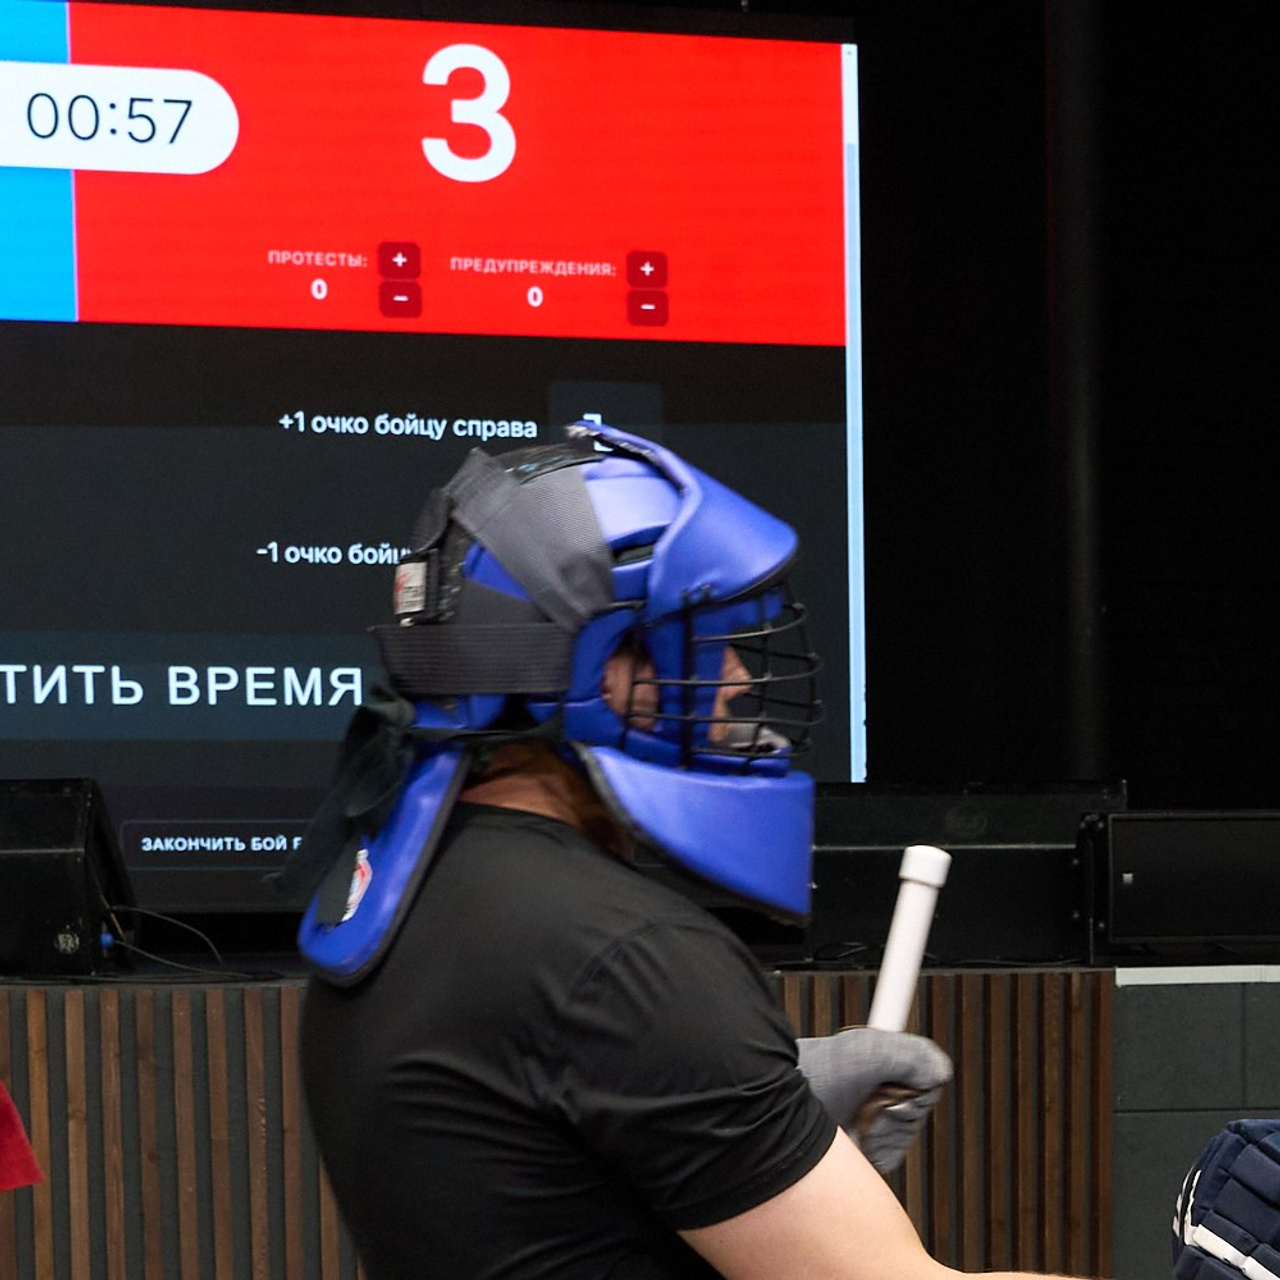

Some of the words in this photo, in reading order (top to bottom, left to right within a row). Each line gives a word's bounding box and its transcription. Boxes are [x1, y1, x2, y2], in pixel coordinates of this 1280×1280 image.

[26, 91, 193, 145] 00:57
[421, 44, 517, 183] 3
[267, 249, 368, 268] ПРОТЕСТЫ:
[450, 256, 616, 277] ПРЕДУПРЕЖДЕНИЯ:
[310, 277, 329, 300] 0
[526, 286, 544, 308] 0
[278, 410, 306, 433] +1
[310, 414, 370, 435] очко
[373, 412, 448, 441] бойцу
[452, 418, 538, 442] справа
[255, 540, 279, 564] -1
[283, 544, 344, 565] очко
[167, 665, 363, 706] ВРЕМЯ
[140, 836, 246, 852] ЗАКОНЧИТЬ
[250, 834, 288, 852] БОЙ
